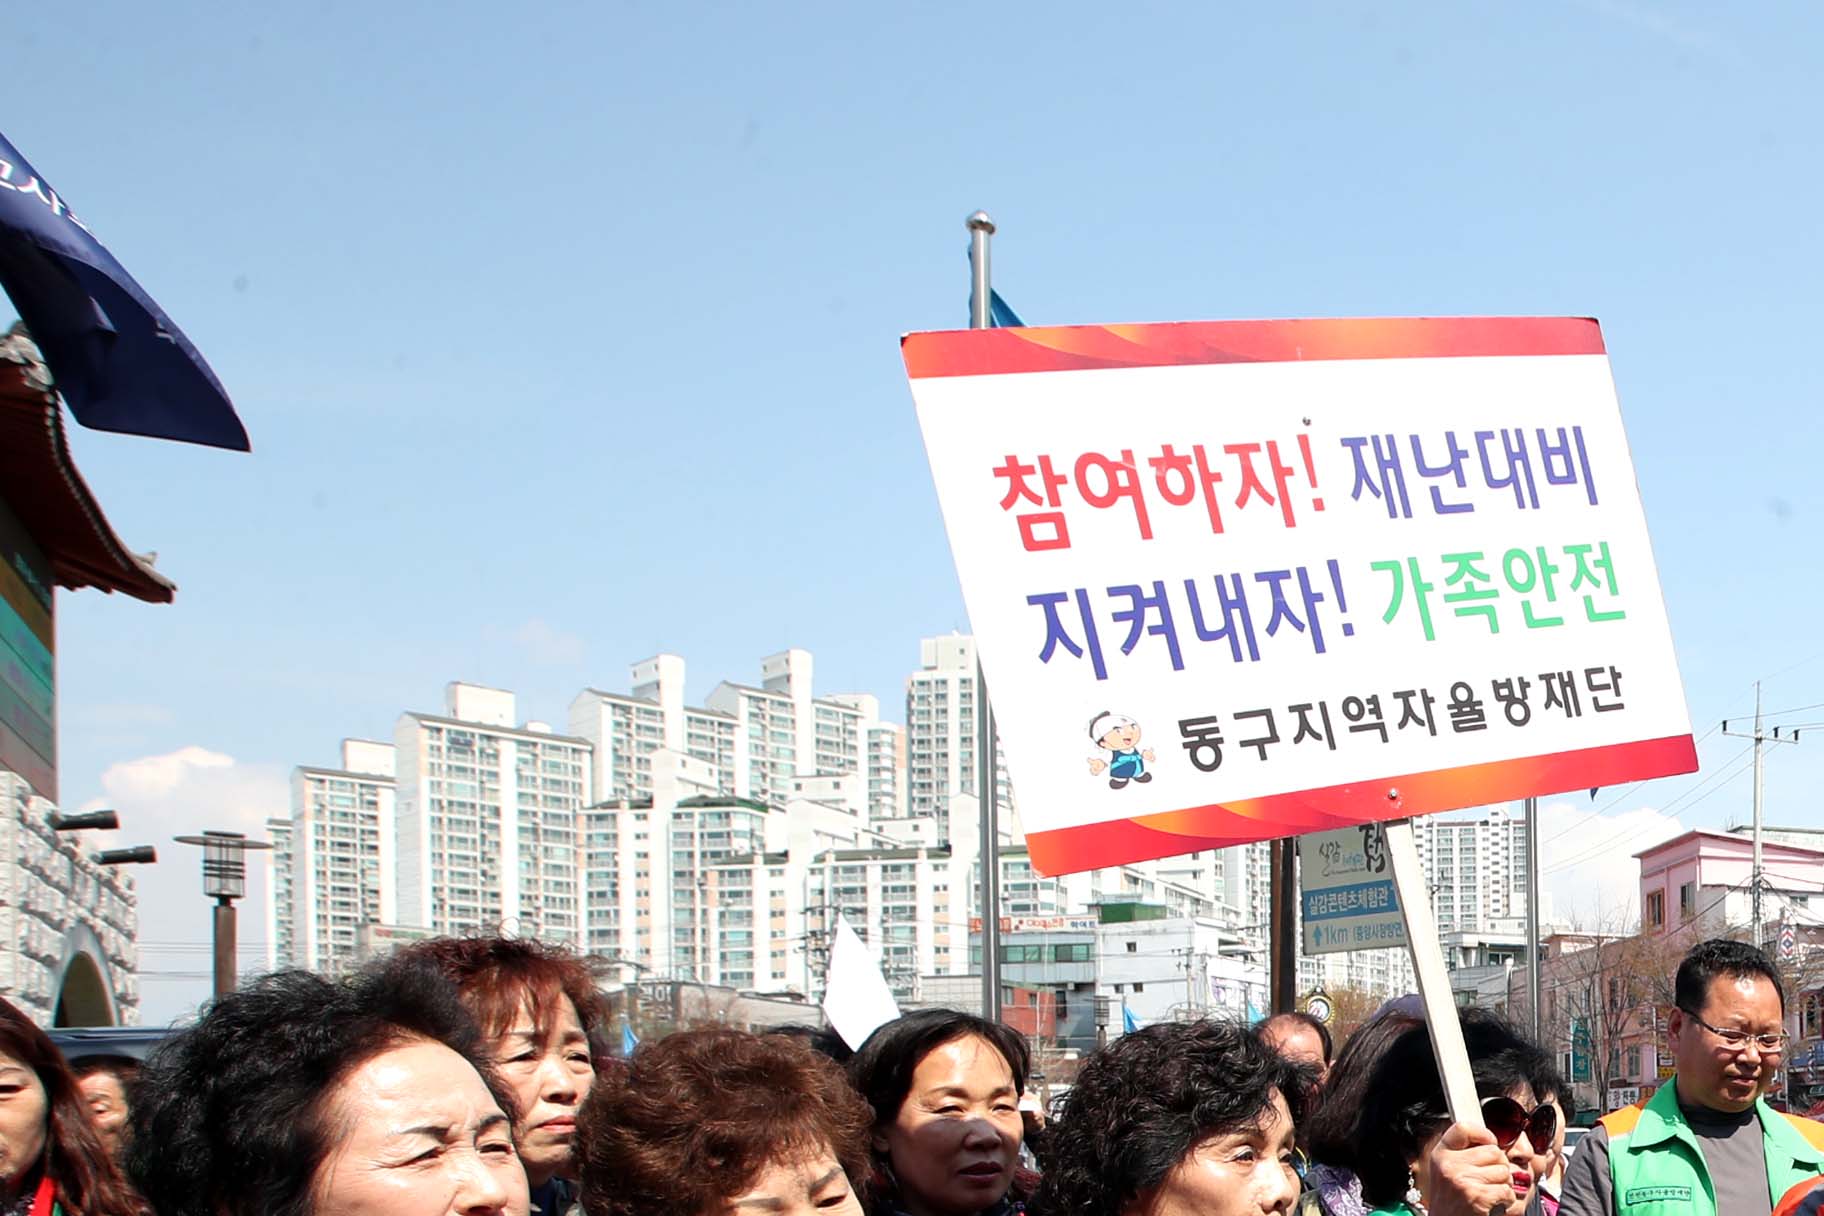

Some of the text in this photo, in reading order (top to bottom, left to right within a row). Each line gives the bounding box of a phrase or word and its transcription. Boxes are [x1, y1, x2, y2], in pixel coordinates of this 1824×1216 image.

[993, 424, 1600, 551] 참여하자! 재난대비
[1026, 541, 1628, 681] 지켜내자! 가족안전
[1178, 665, 1627, 772] 동구지역자율방재단
[1324, 924, 1348, 944] 1km
